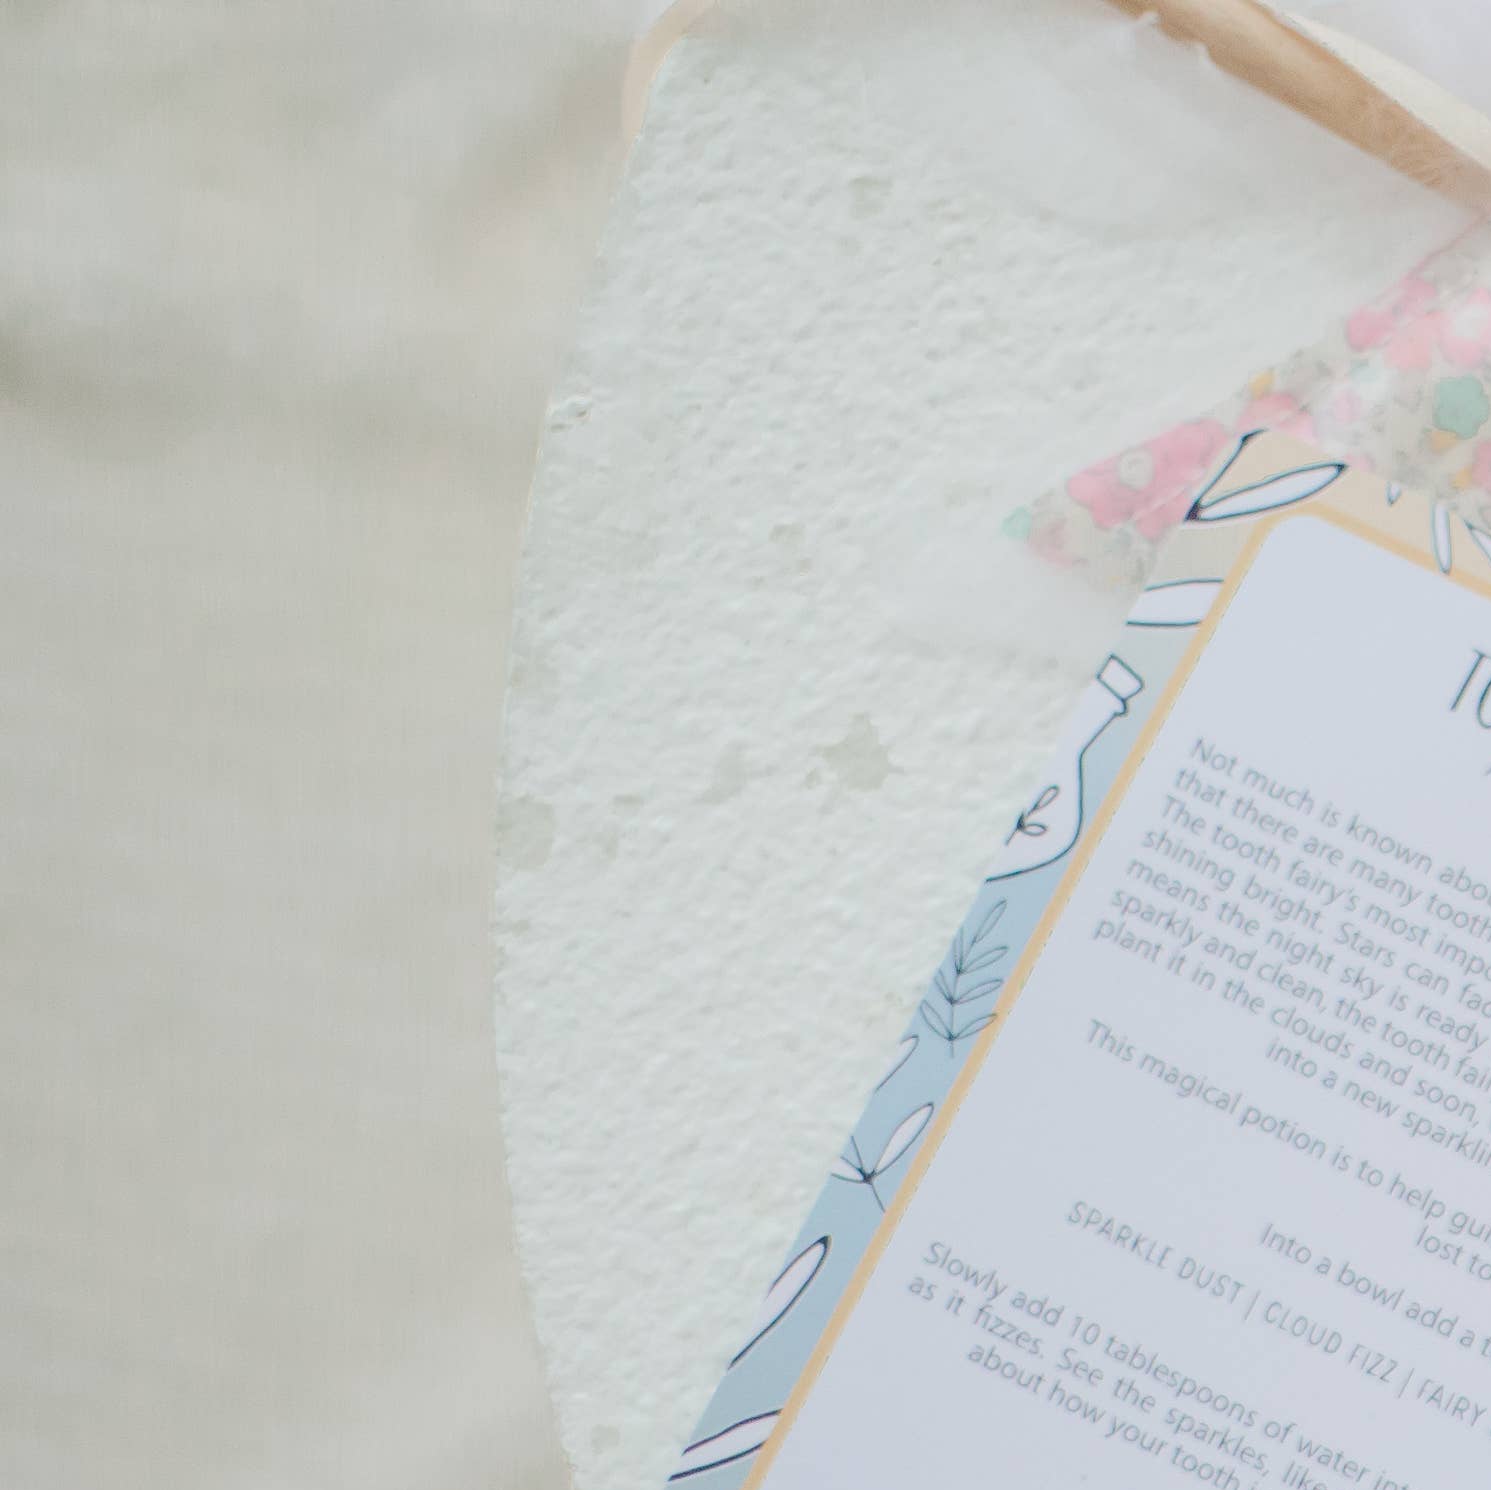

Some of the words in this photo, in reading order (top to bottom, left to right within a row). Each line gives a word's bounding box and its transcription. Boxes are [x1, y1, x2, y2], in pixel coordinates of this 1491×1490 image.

[1174, 768, 1227, 807] that
[1232, 797, 1298, 843] there
[1303, 837, 1344, 866] are
[1349, 859, 1422, 908] many
[1189, 736, 1238, 777] Not
[1242, 768, 1315, 815] much
[1320, 801, 1341, 828] is
[1346, 814, 1433, 874] known
[1087, 1018, 1136, 1062] This
[1138, 1053, 1243, 1115] magical
[1238, 1105, 1327, 1160] potion
[1329, 1145, 1353, 1172] is
[1355, 1159, 1384, 1188] to
[1386, 1172, 1446, 1221] help
[1265, 1037, 1318, 1079] into
[1320, 1070, 1338, 1090] a
[1341, 1080, 1400, 1118] new
[1066, 1200, 1174, 1270] SPARKLE
[1176, 1256, 1246, 1304] DUST
[1263, 1300, 1343, 1354] CLOUD
[1347, 1343, 1398, 1383] FIZZ
[1416, 1378, 1487, 1428] FAIRY
[1415, 1224, 1464, 1266] lost
[922, 1241, 1009, 1302] Slowly
[1010, 1291, 1066, 1328] add
[1069, 1314, 1101, 1347] 10
[1104, 1335, 1258, 1428] tablespoons
[1263, 1420, 1298, 1444] of
[1296, 1435, 1371, 1483] water
